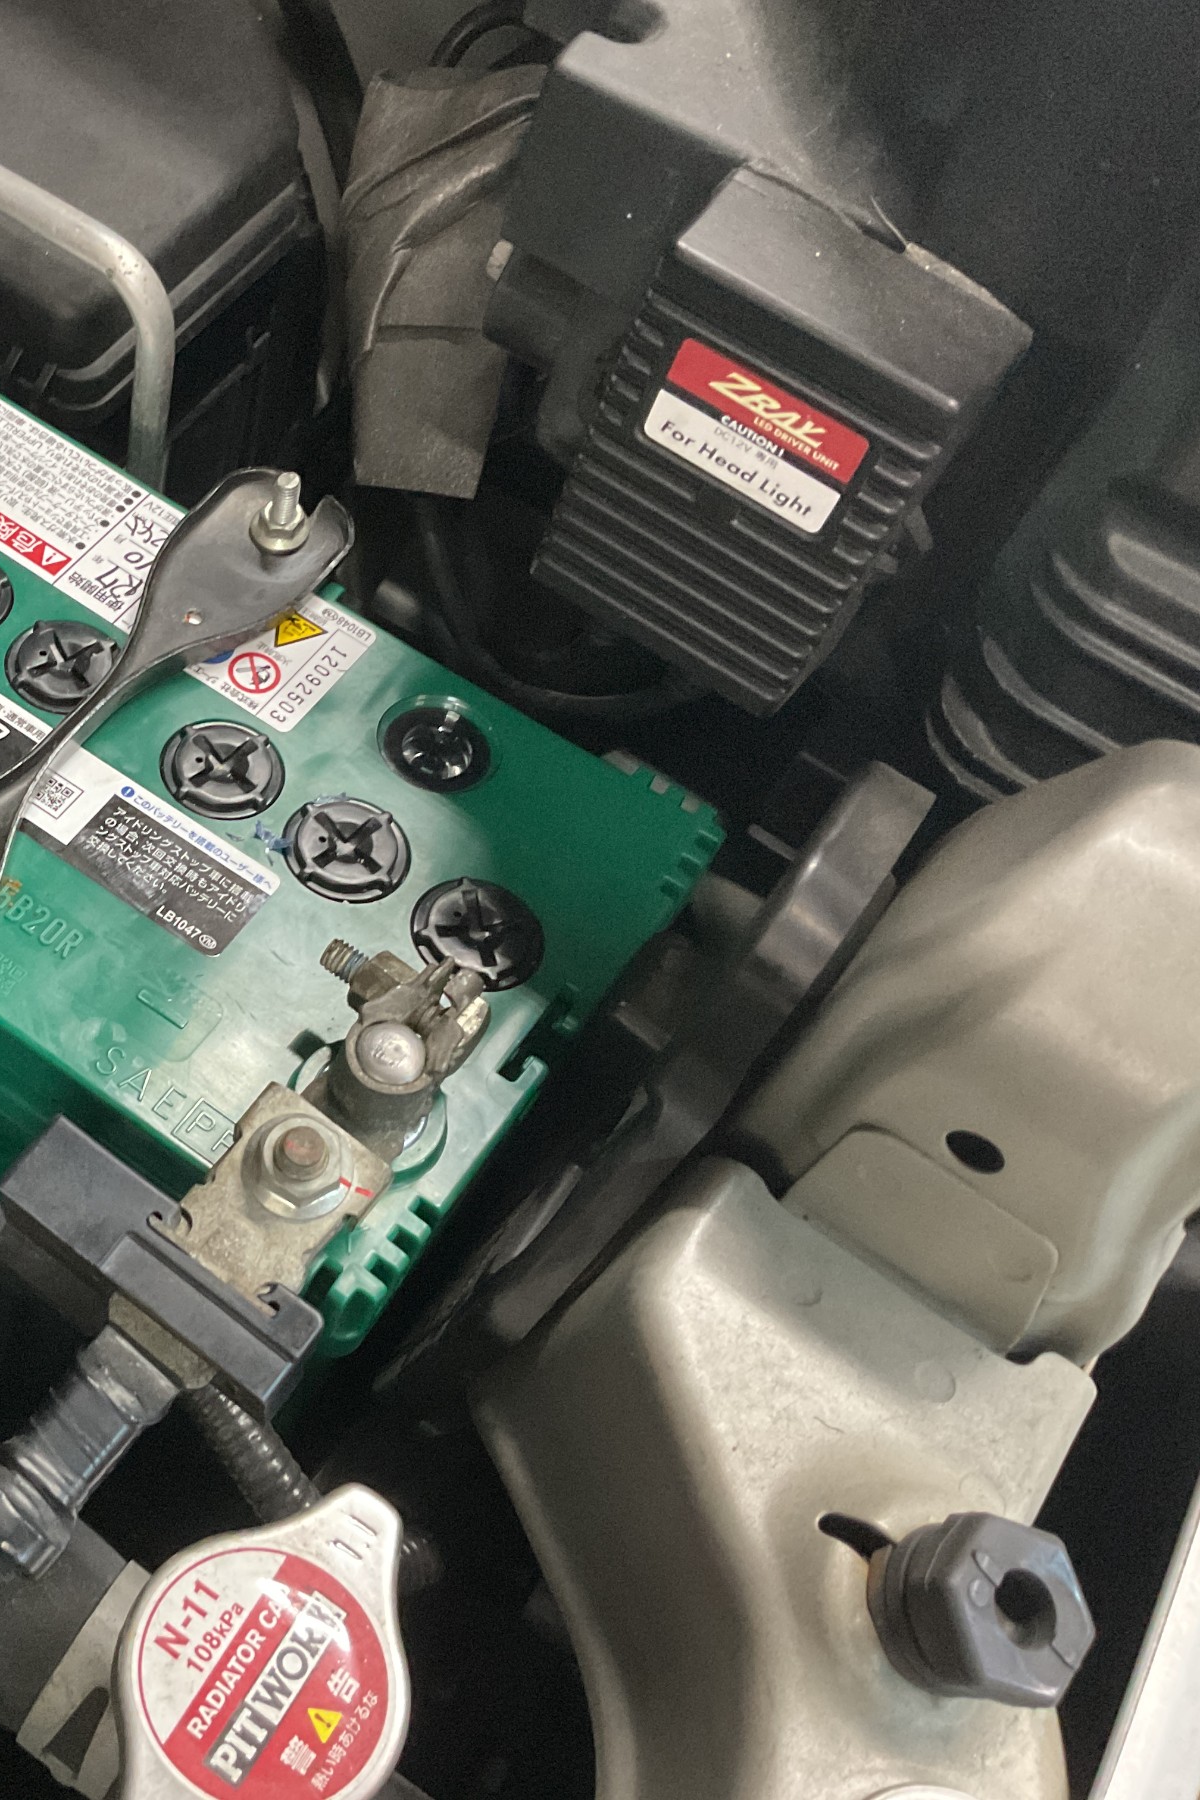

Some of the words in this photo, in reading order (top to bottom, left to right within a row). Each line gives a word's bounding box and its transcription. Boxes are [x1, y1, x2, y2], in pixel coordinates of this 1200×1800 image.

[708, 369, 826, 449] ZRAY
[713, 426, 752, 454] DC12V
[753, 416, 773, 432] LED
[773, 428, 812, 455] DRIVER
[811, 450, 839, 471] UNIT
[660, 420, 695, 447] For
[697, 442, 758, 483] Head
[758, 478, 813, 517] Light
[66, 570, 125, 611] 使用開始
[91, 553, 104, 564] 年
[335, 615, 371, 641] LB1048
[219, 682, 259, 710] 株式会社
[268, 645, 347, 723] 12092503
[104, 816, 246, 912] の場合、次回交換時もアイドリ
[155, 905, 202, 940] LB1047
[96, 1049, 185, 1120] SAE
[154, 1580, 220, 1660] N-11
[184, 1599, 244, 1674] 108kPa
[186, 1628, 266, 1740] RADIATOR
[277, 1734, 319, 1776] 警
[323, 1664, 362, 1704] 告
[310, 1689, 379, 1791] 熱い時あけるな
